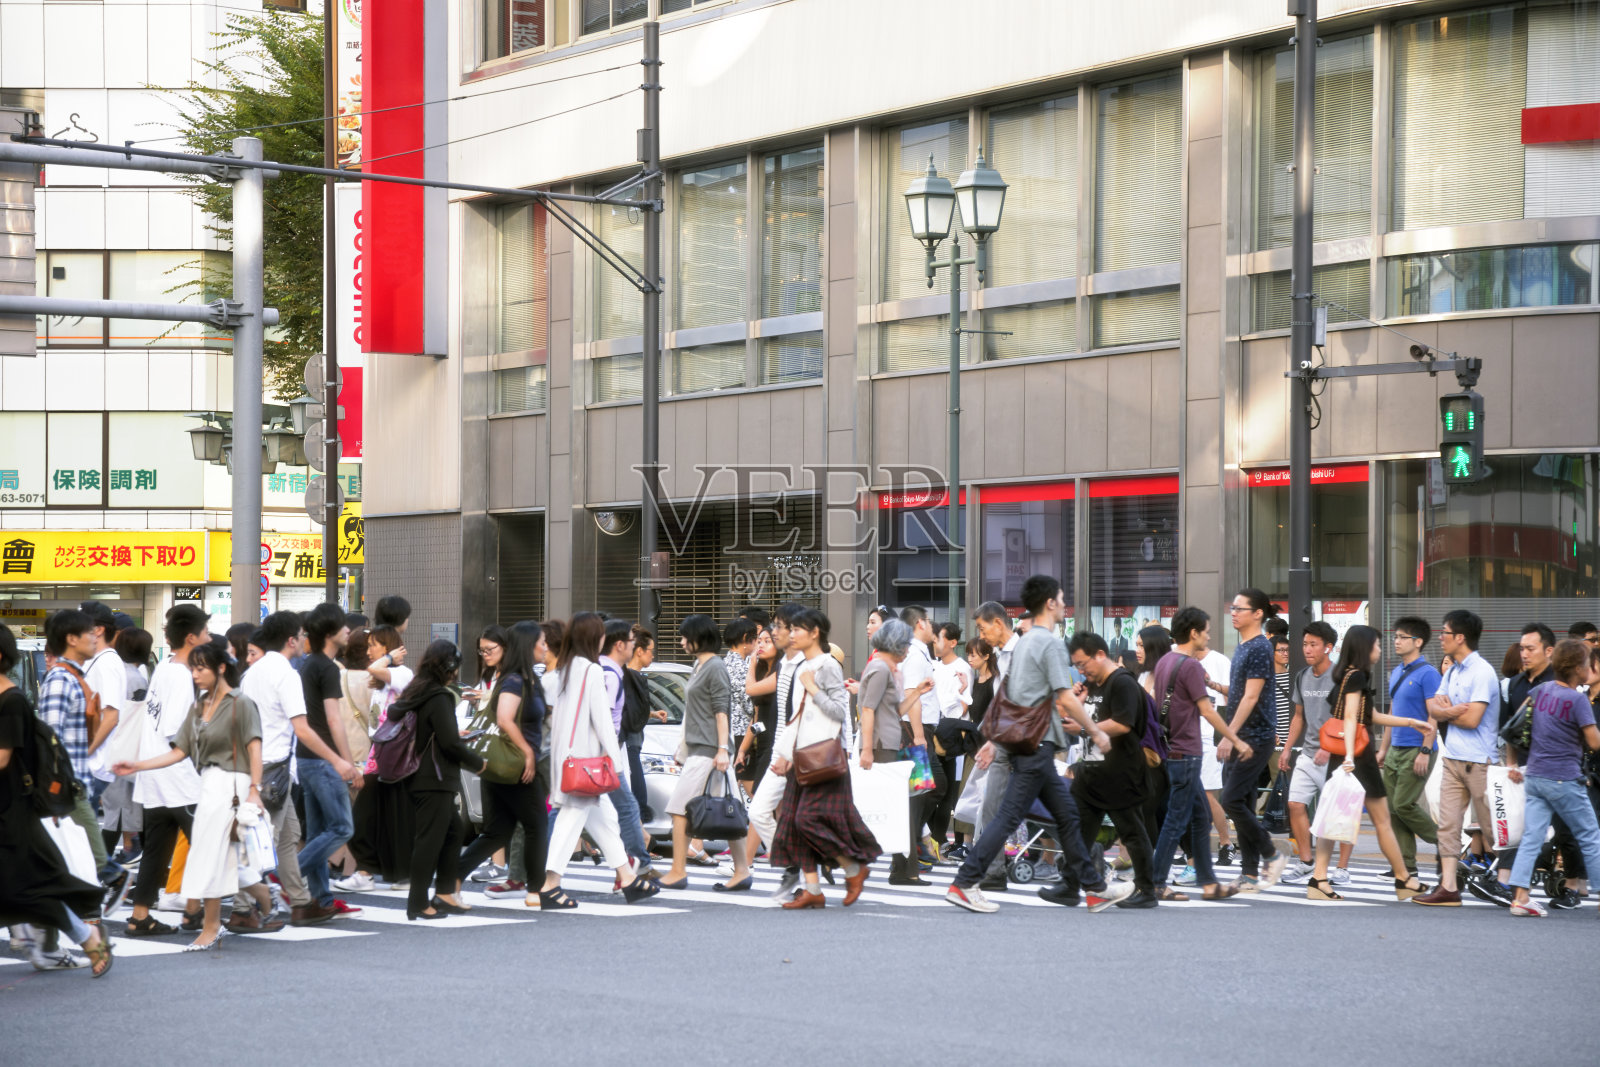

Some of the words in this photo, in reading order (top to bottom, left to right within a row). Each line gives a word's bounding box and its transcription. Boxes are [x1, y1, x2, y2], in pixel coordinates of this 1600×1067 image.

[1324, 469, 1335, 478] UFJ
[55, 546, 86, 557] カメラ
[88, 545, 195, 567] 交換下取り
[55, 557, 86, 568] レンズ
[1494, 782, 1506, 819] JEANS
